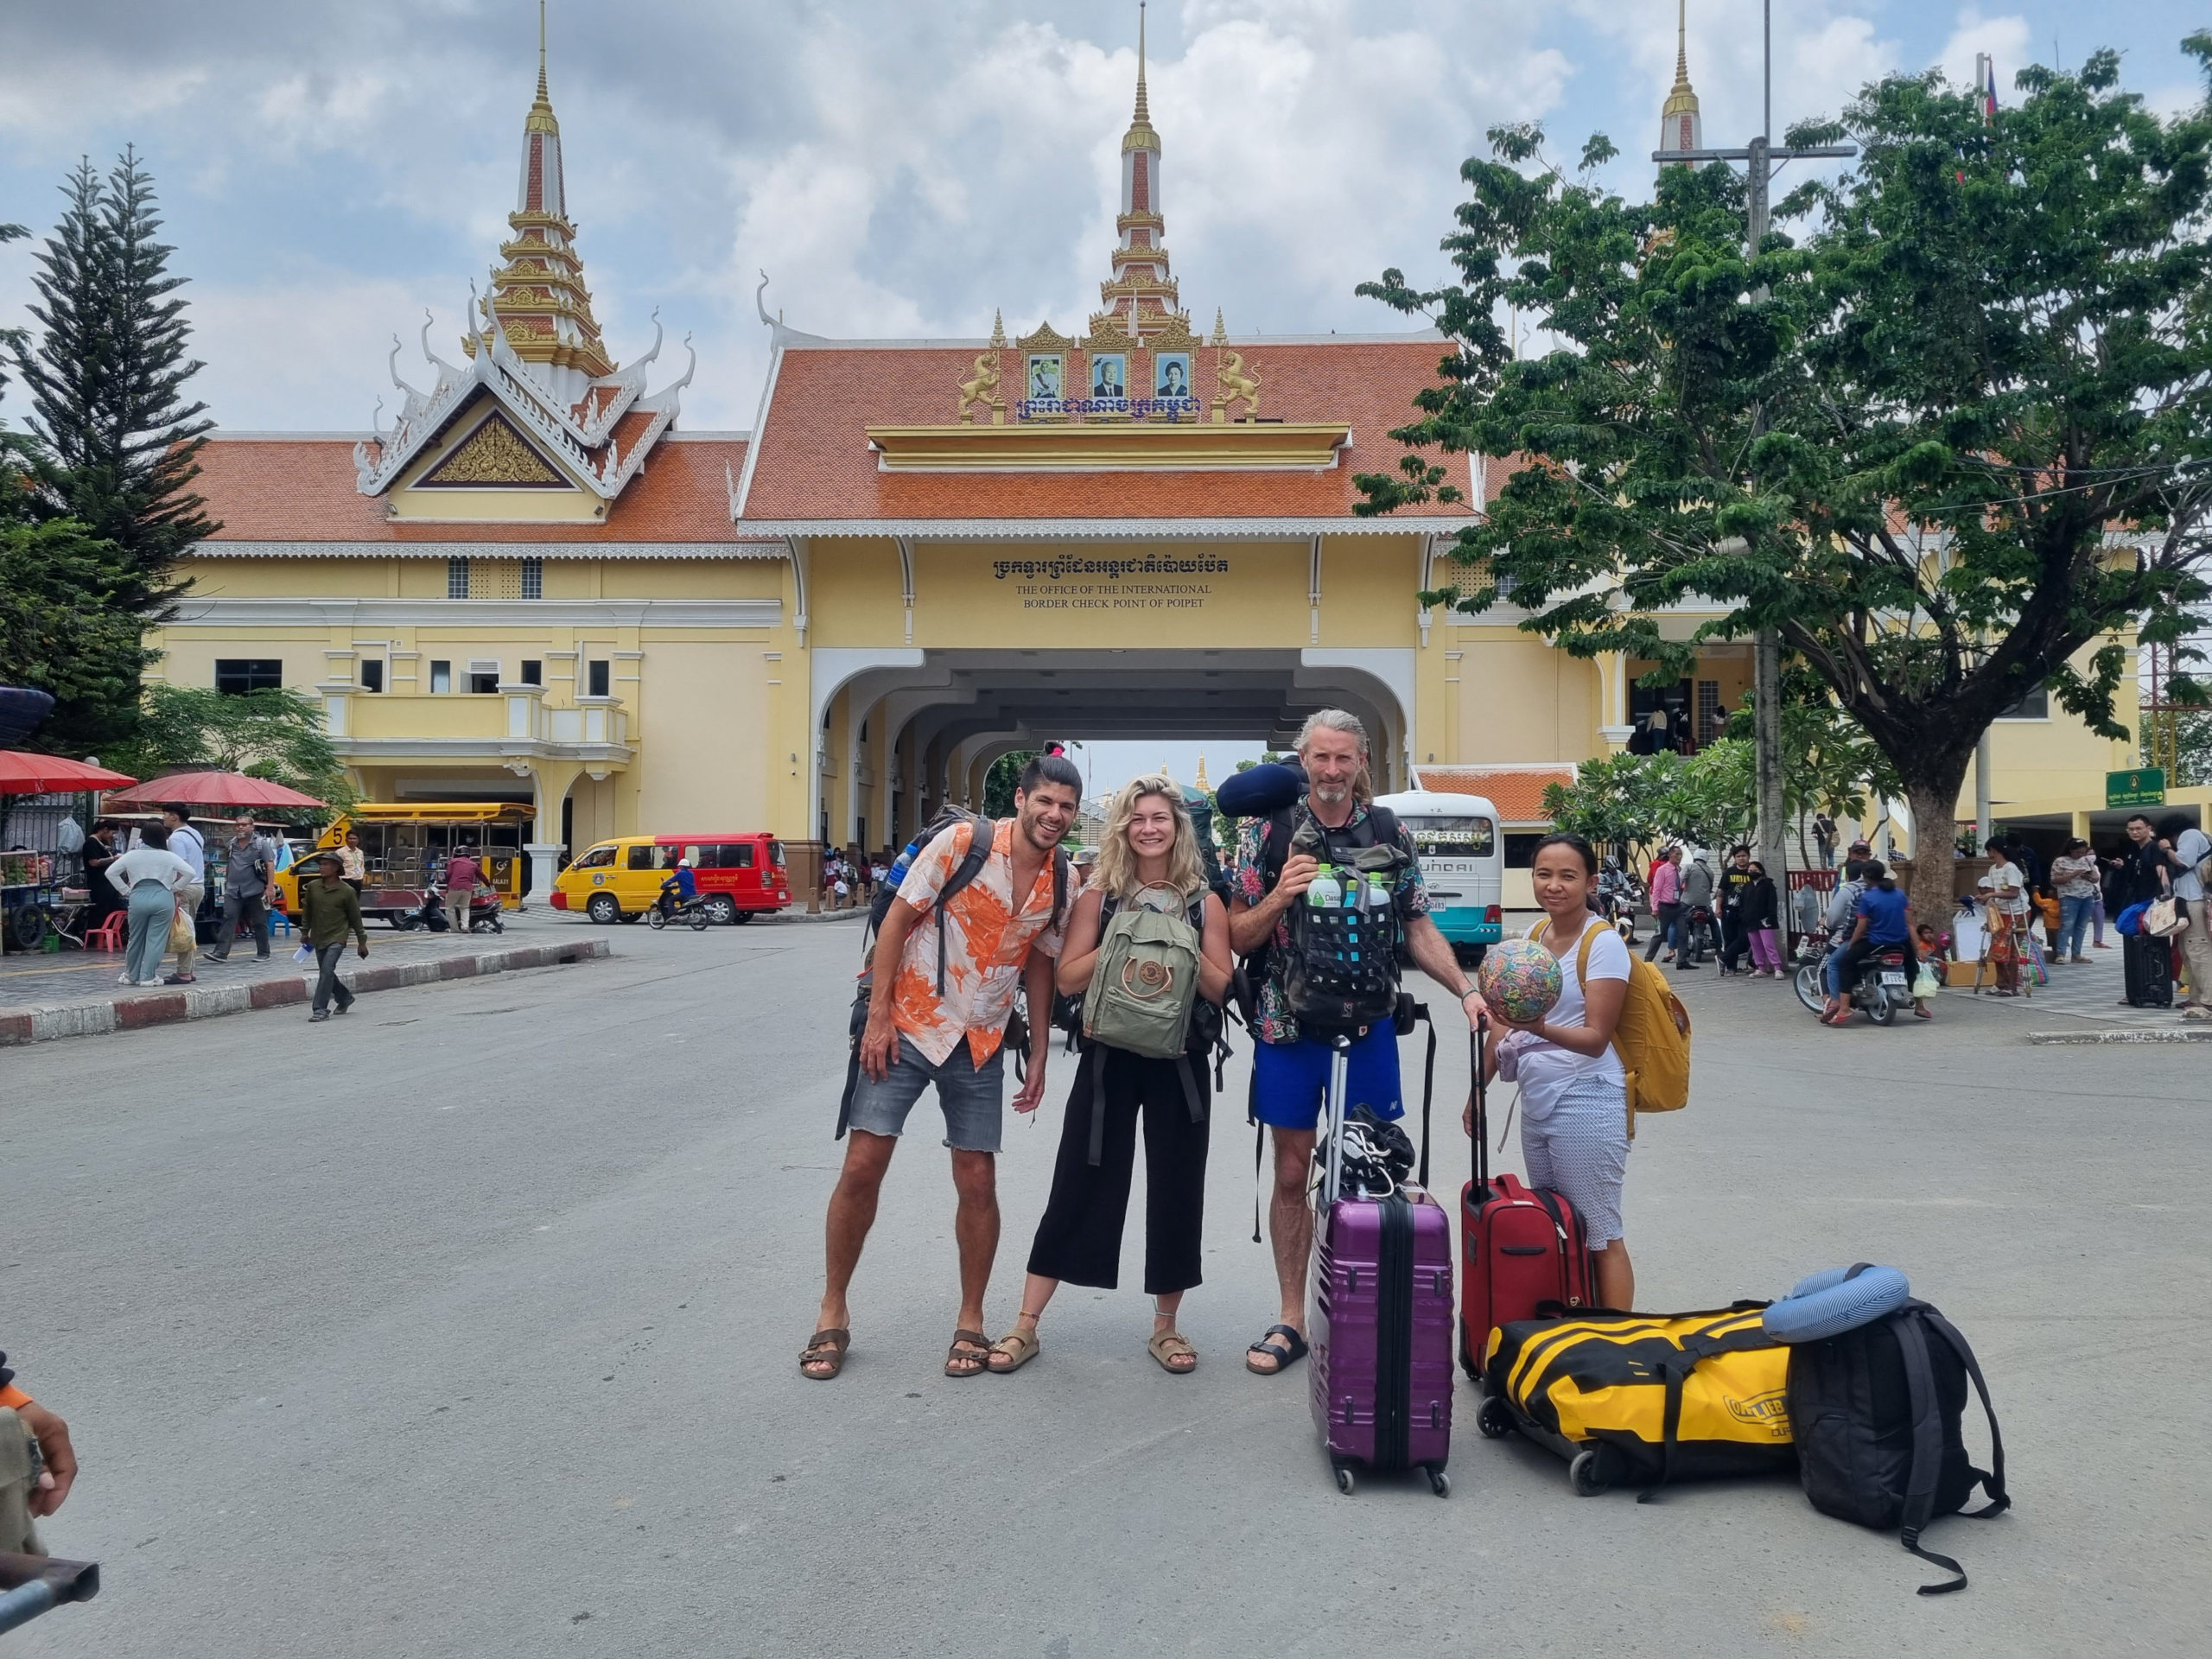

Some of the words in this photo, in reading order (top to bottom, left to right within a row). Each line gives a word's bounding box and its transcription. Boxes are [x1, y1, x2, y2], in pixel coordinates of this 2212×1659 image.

[1015, 585, 1037, 594] THE
[1039, 585, 1077, 594] OFFICE
[1080, 585, 1094, 594] OF
[1097, 585, 1119, 594] THE
[1122, 584, 1211, 594] INTERNATIONAL
[1024, 599, 1069, 608] BORDER
[1071, 599, 1109, 608] CHECK
[1113, 599, 1147, 608] POINT
[1149, 599, 1164, 608] OF
[1166, 599, 1205, 608] POIPET
[334, 827, 342, 845] 5
[1420, 863, 1472, 872] UNDAI
[1730, 1396, 1786, 1420] ORLIEB
